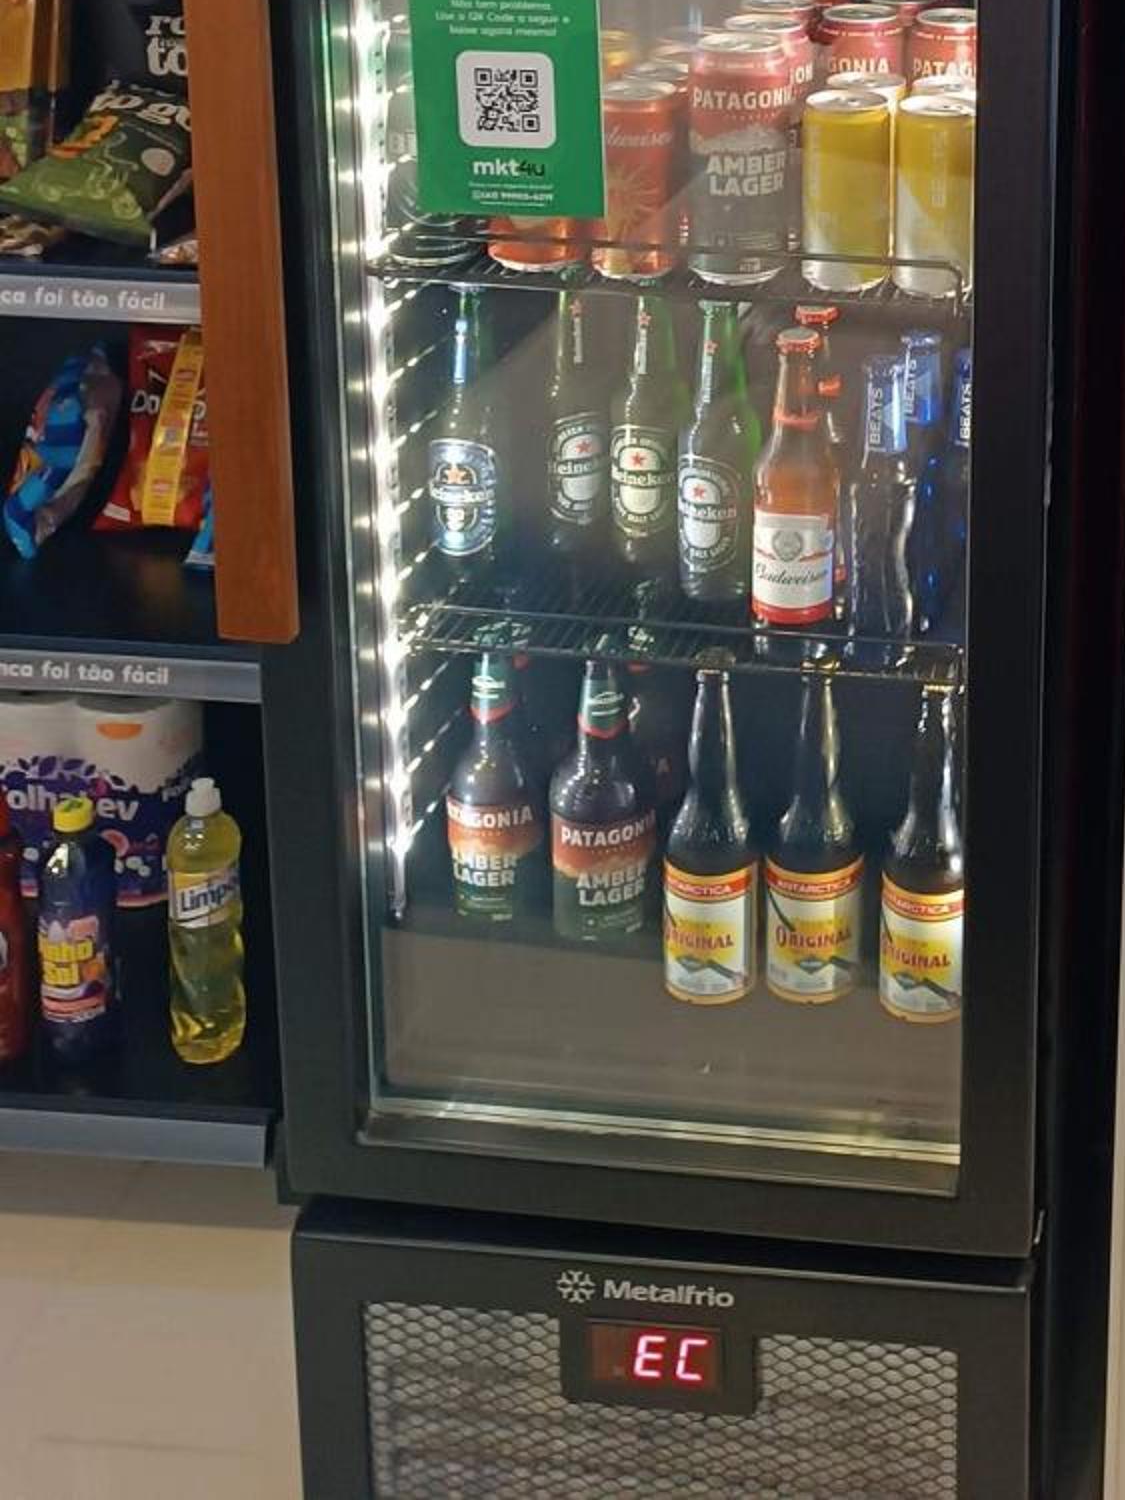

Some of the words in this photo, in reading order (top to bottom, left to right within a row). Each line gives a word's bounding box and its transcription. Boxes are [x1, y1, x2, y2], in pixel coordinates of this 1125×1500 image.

[706, 151, 787, 176] AMBER
[709, 172, 785, 197] LAGER
[34, 285, 63, 306] foi
[73, 288, 109, 310] tão
[118, 288, 165, 311] fácil
[42, 660, 70, 680] foi
[77, 662, 115, 683] tão
[122, 665, 169, 686] fácil
[453, 862, 515, 887] LAGER
[776, 925, 851, 949] ORIGINAL
[603, 1278, 735, 1308] Metalfrio
[633, 1335, 709, 1382] EC
